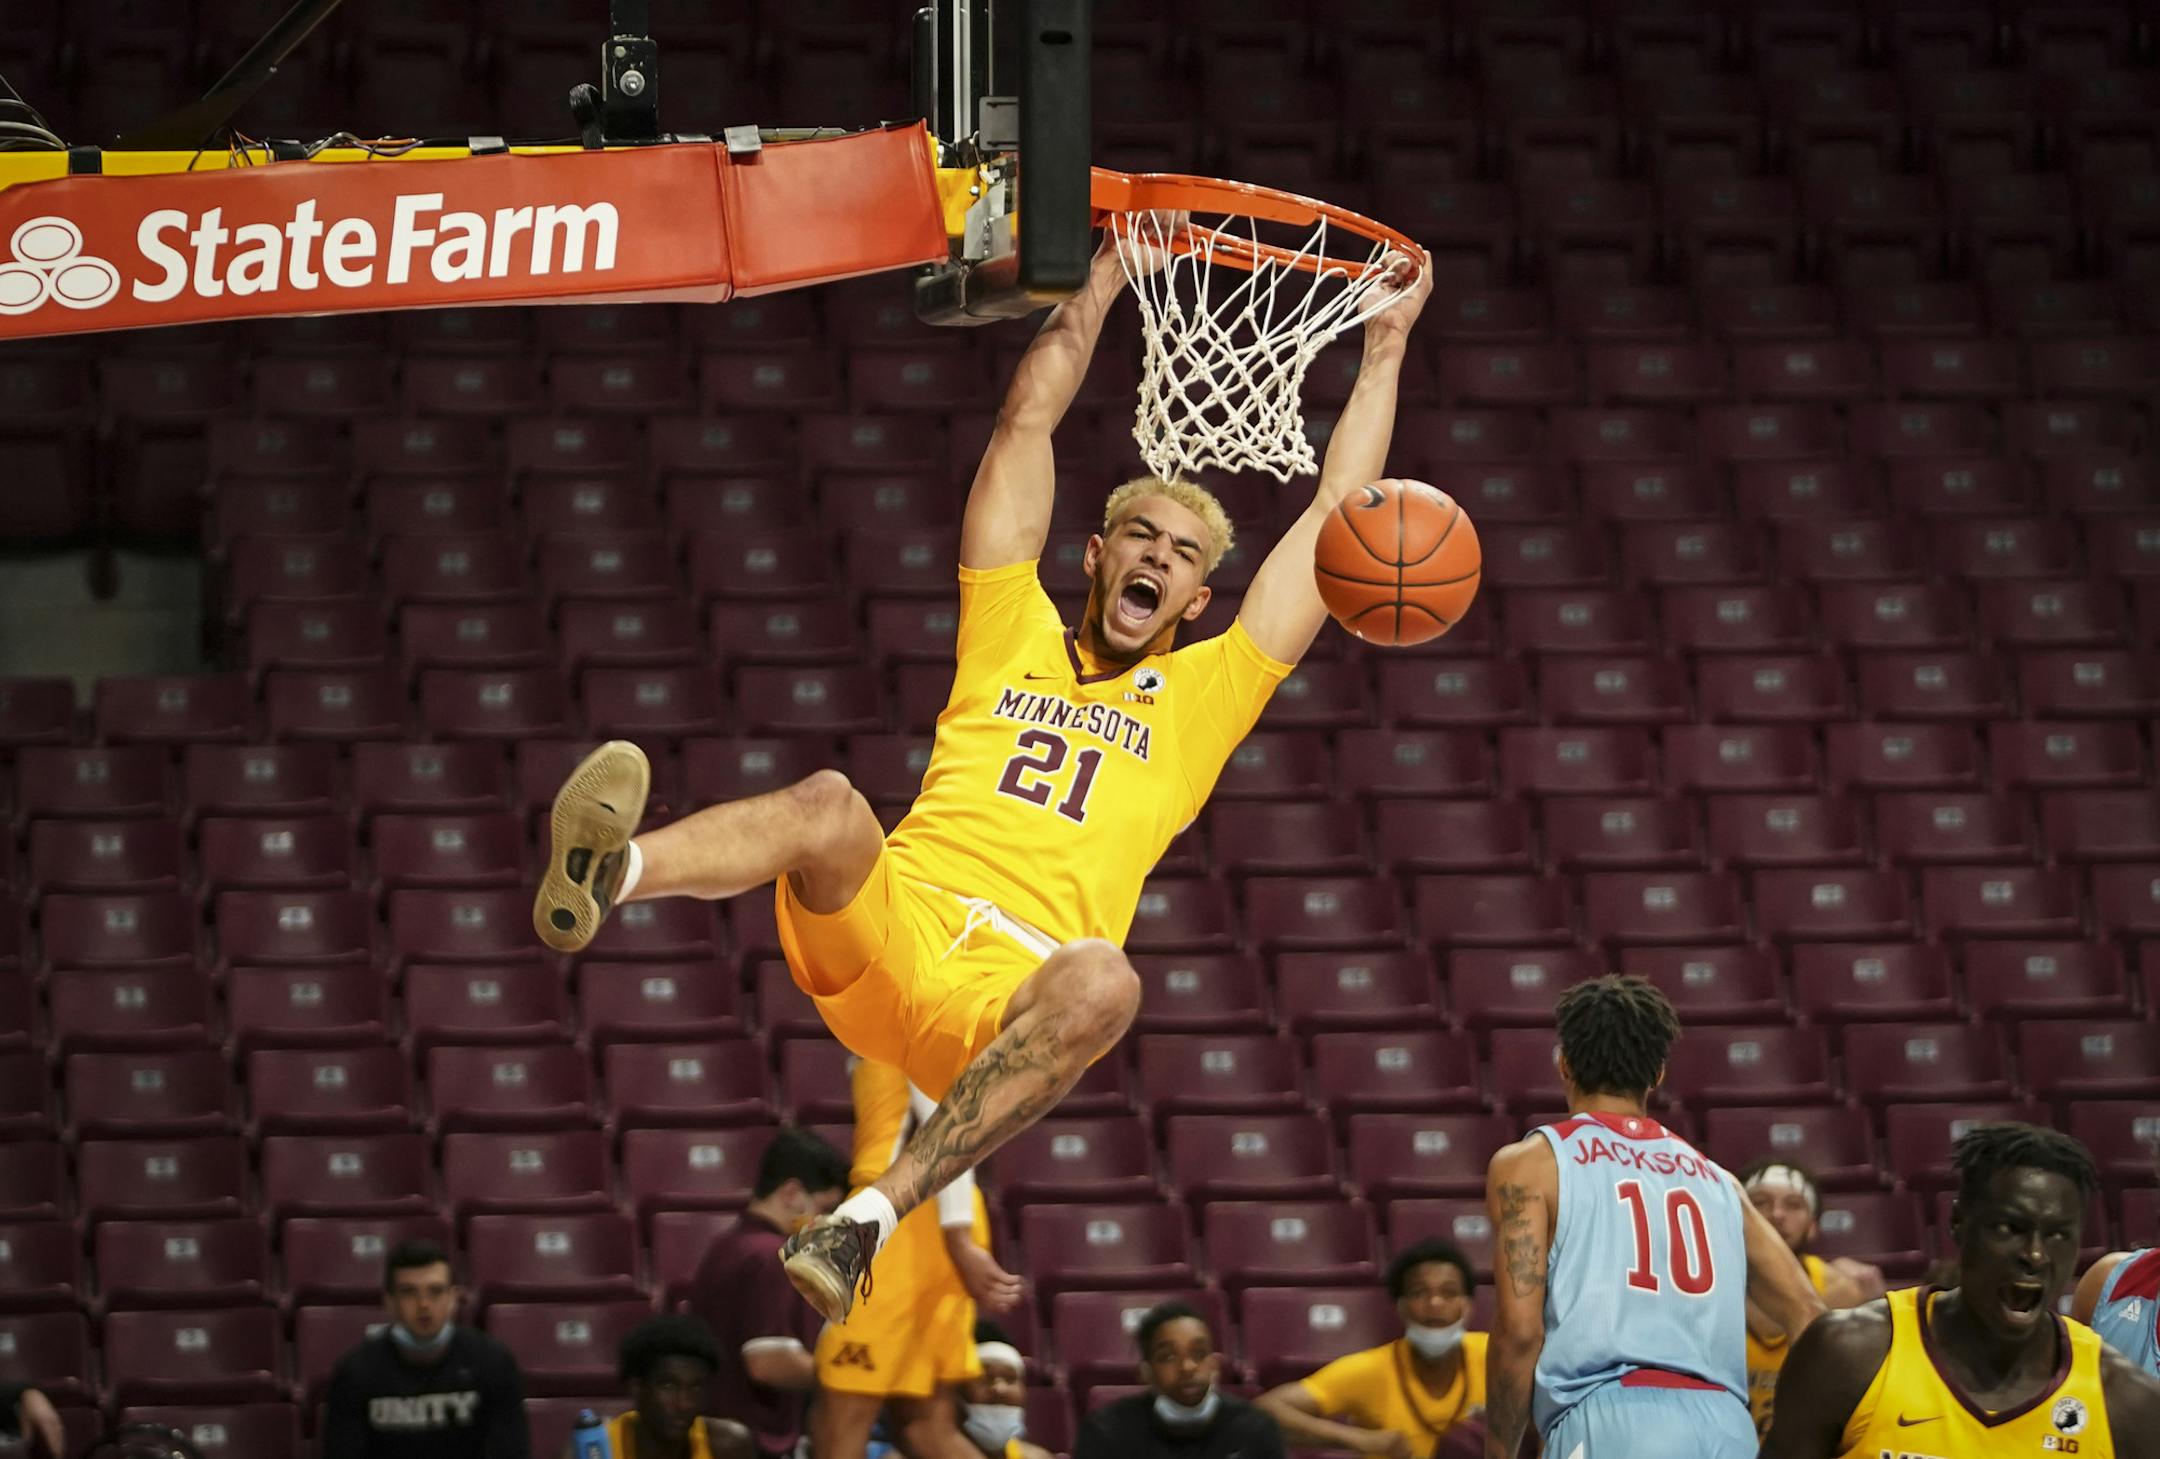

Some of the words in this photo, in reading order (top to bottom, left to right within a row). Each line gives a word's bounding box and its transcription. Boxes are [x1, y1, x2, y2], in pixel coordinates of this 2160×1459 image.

[993, 687, 1150, 761] MINNESOTA
[997, 728, 1102, 823] 21
[1573, 1136, 1721, 1185] JACKSON
[1615, 1179, 1715, 1297] 10
